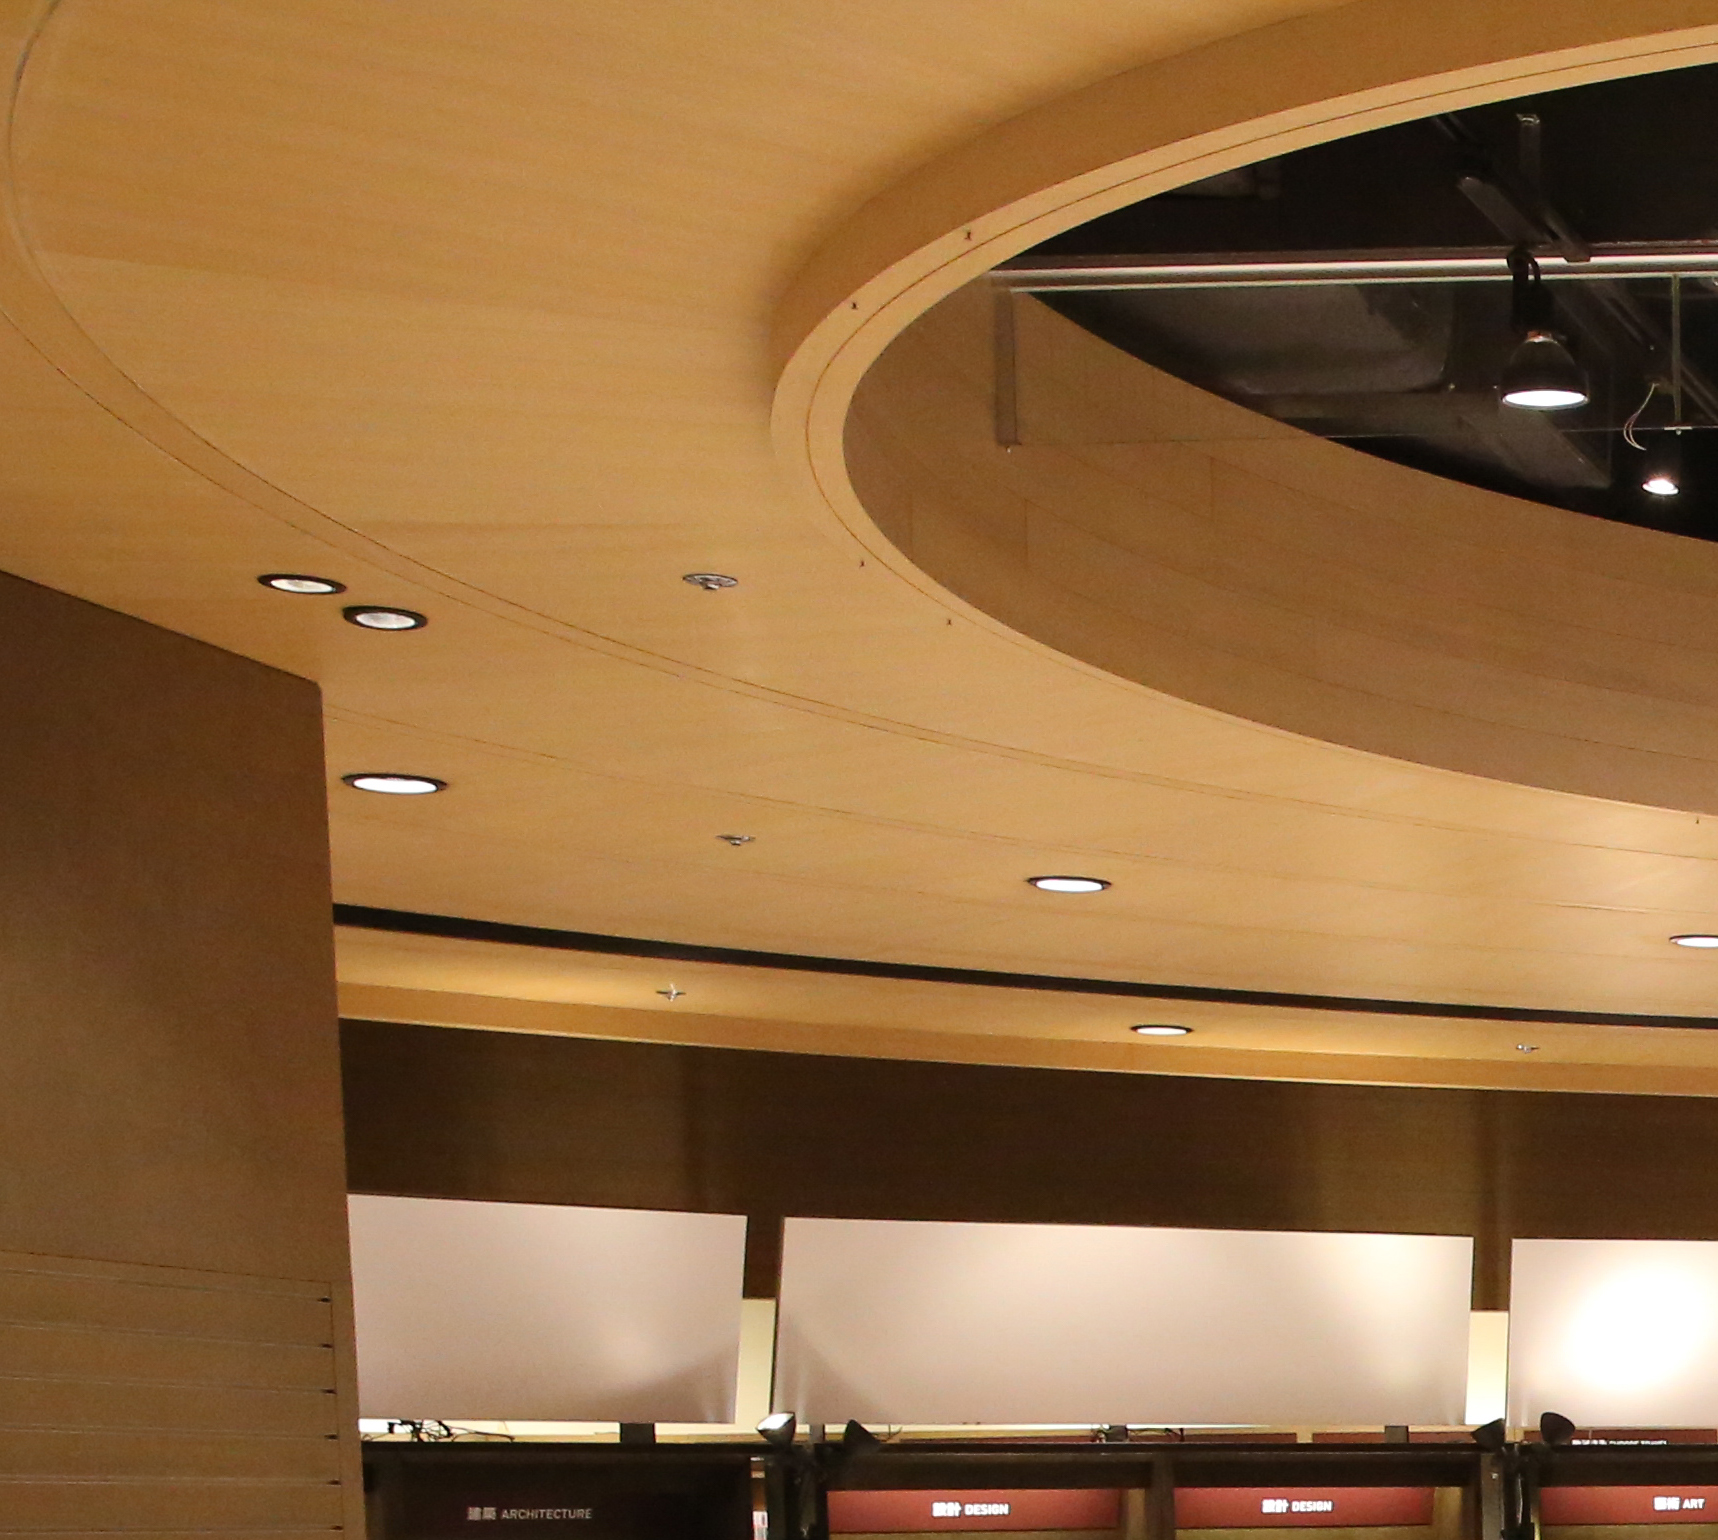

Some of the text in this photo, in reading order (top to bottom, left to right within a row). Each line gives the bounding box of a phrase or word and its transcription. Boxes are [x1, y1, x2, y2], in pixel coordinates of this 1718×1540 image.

[964, 1503, 1010, 1516] DESIGN
[1291, 1500, 1333, 1512] DESIGN
[1682, 1498, 1705, 1510] ART
[501, 1508, 593, 1520] ARCHITECTURE
